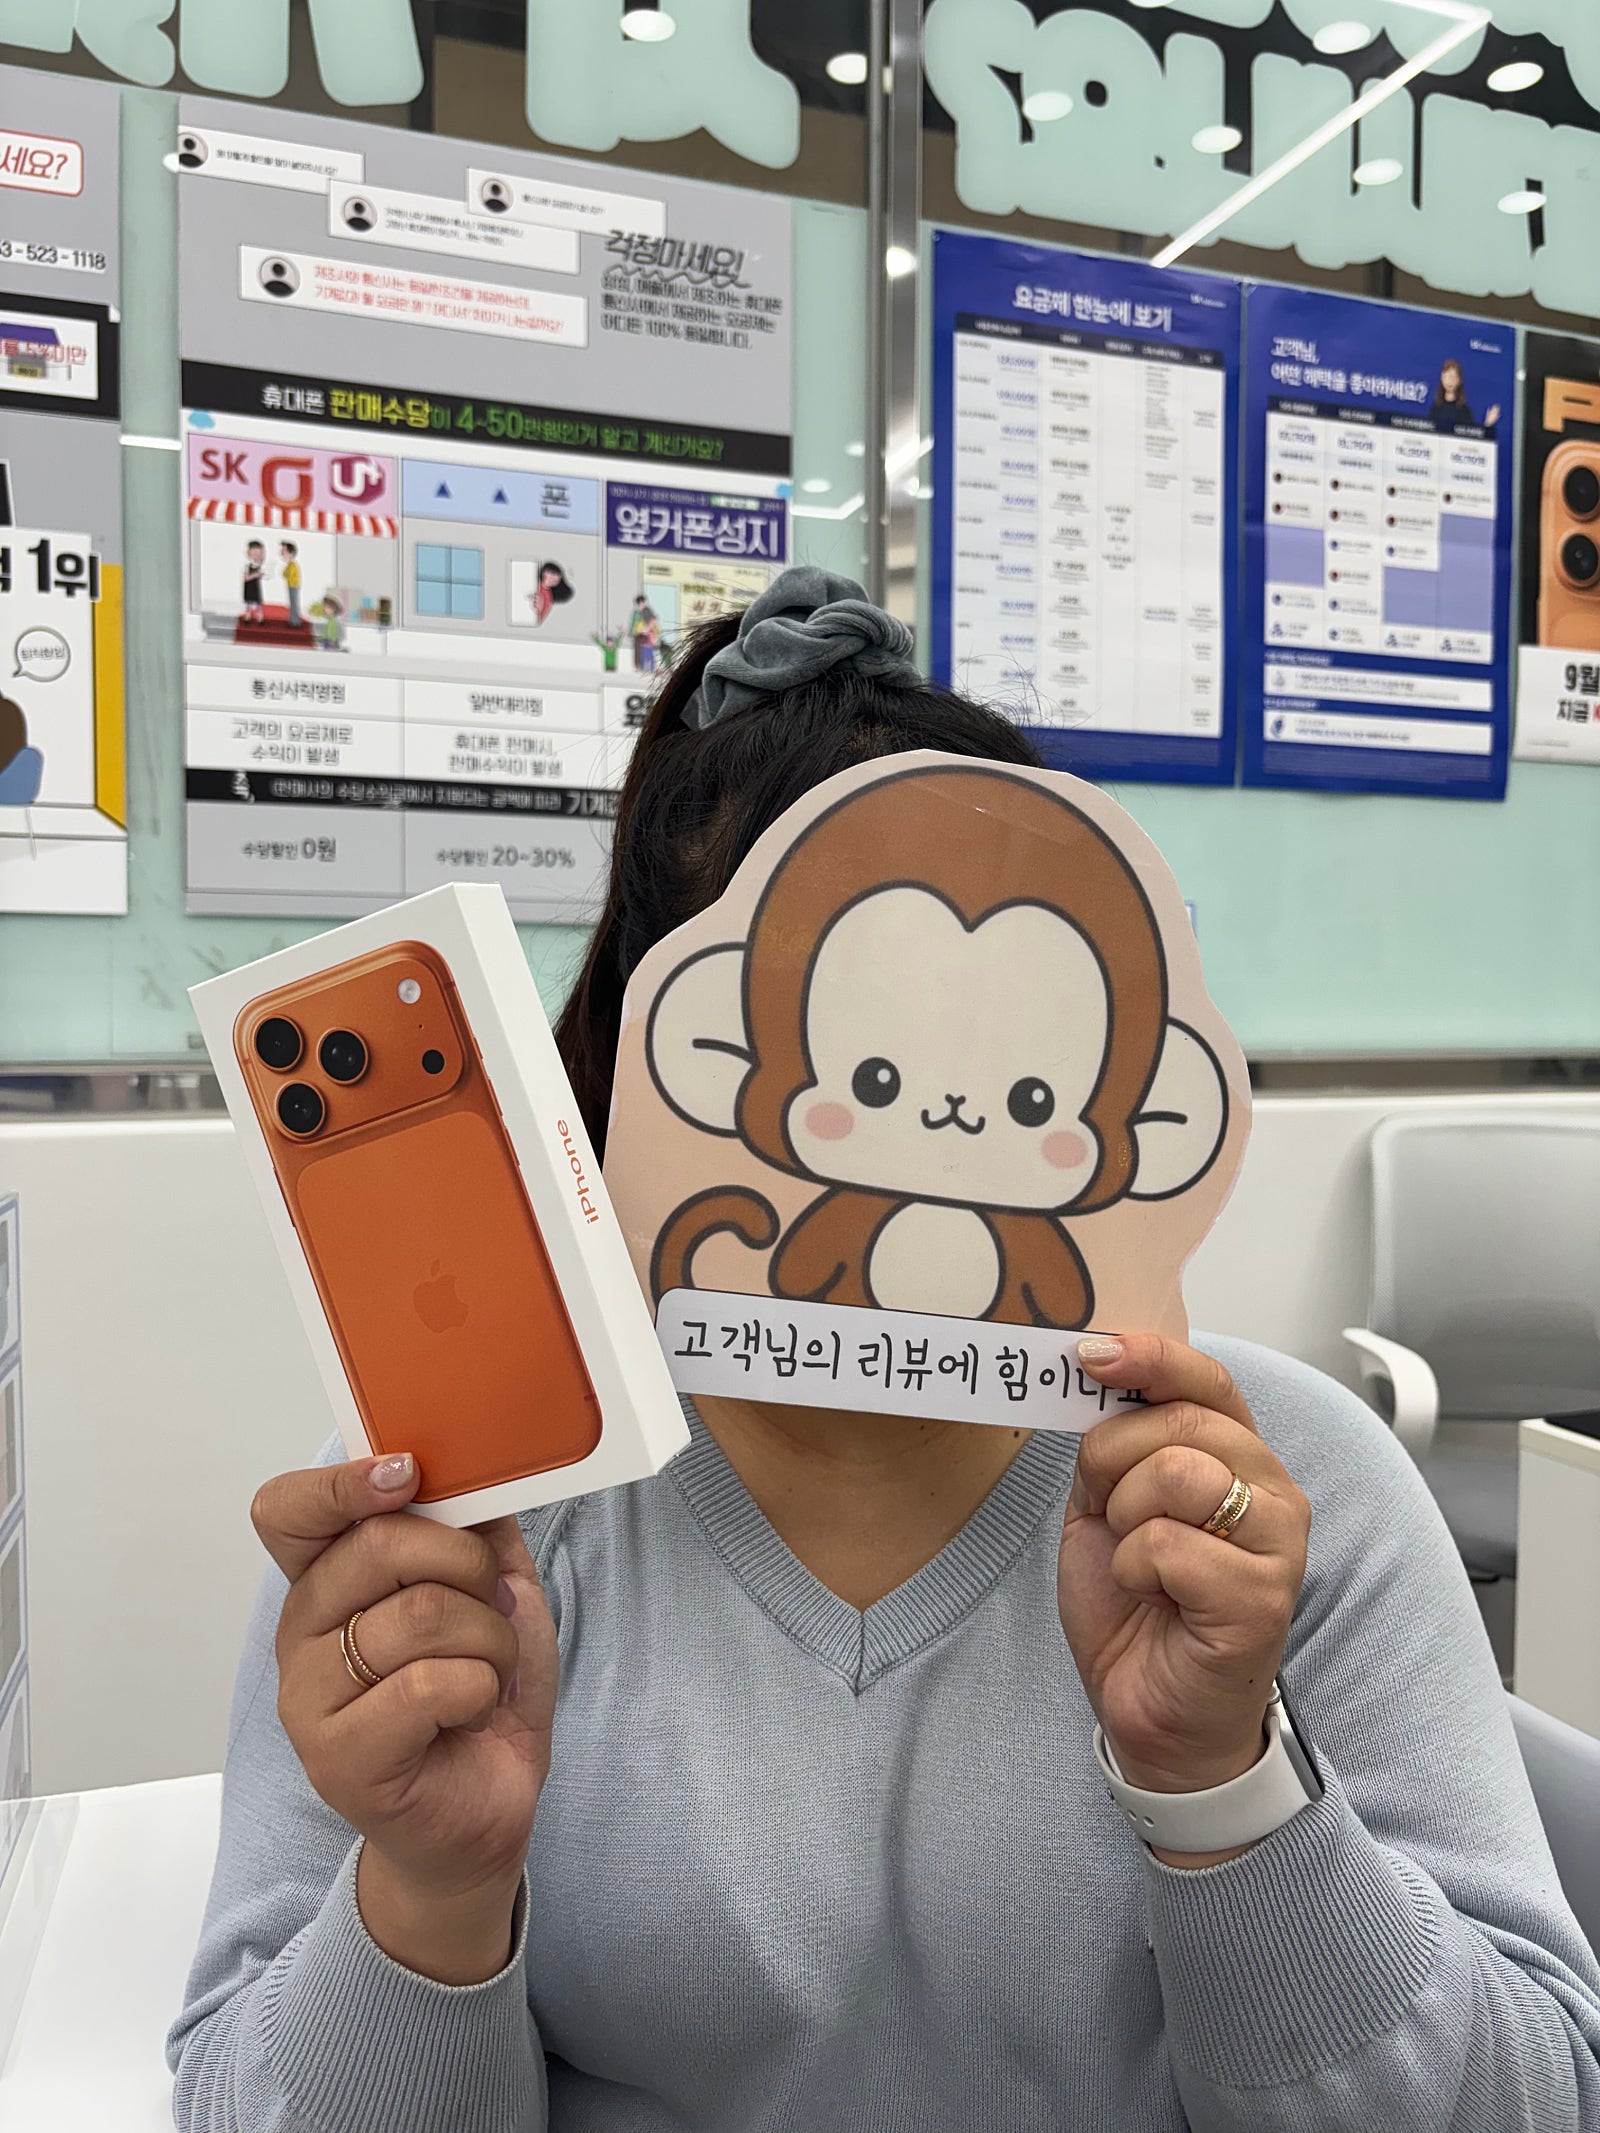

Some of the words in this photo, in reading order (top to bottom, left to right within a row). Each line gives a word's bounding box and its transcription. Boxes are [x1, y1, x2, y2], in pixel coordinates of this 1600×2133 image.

[0, 145, 69, 180] 세요?
[0, 240, 106, 270] 3-523-1118
[1012, 284, 1070, 317] 요금제
[1072, 293, 1131, 327] 한눈에
[1133, 303, 1173, 333] 보기
[1270, 363, 1302, 387] 어떤
[1350, 373, 1428, 403] 좋아하세요?
[263, 384, 325, 415] 휴대폰
[602, 426, 638, 450] 알고
[201, 449, 248, 485] SK
[541, 483, 570, 519] 폰
[615, 503, 779, 558] 옆커폰성지
[28, 538, 99, 599] 1위
[301, 836, 336, 862] 0원
[557, 1119, 600, 1225] iPhone
[673, 1317, 840, 1380] 고객님의
[858, 1331, 979, 1395] 리뷰에
